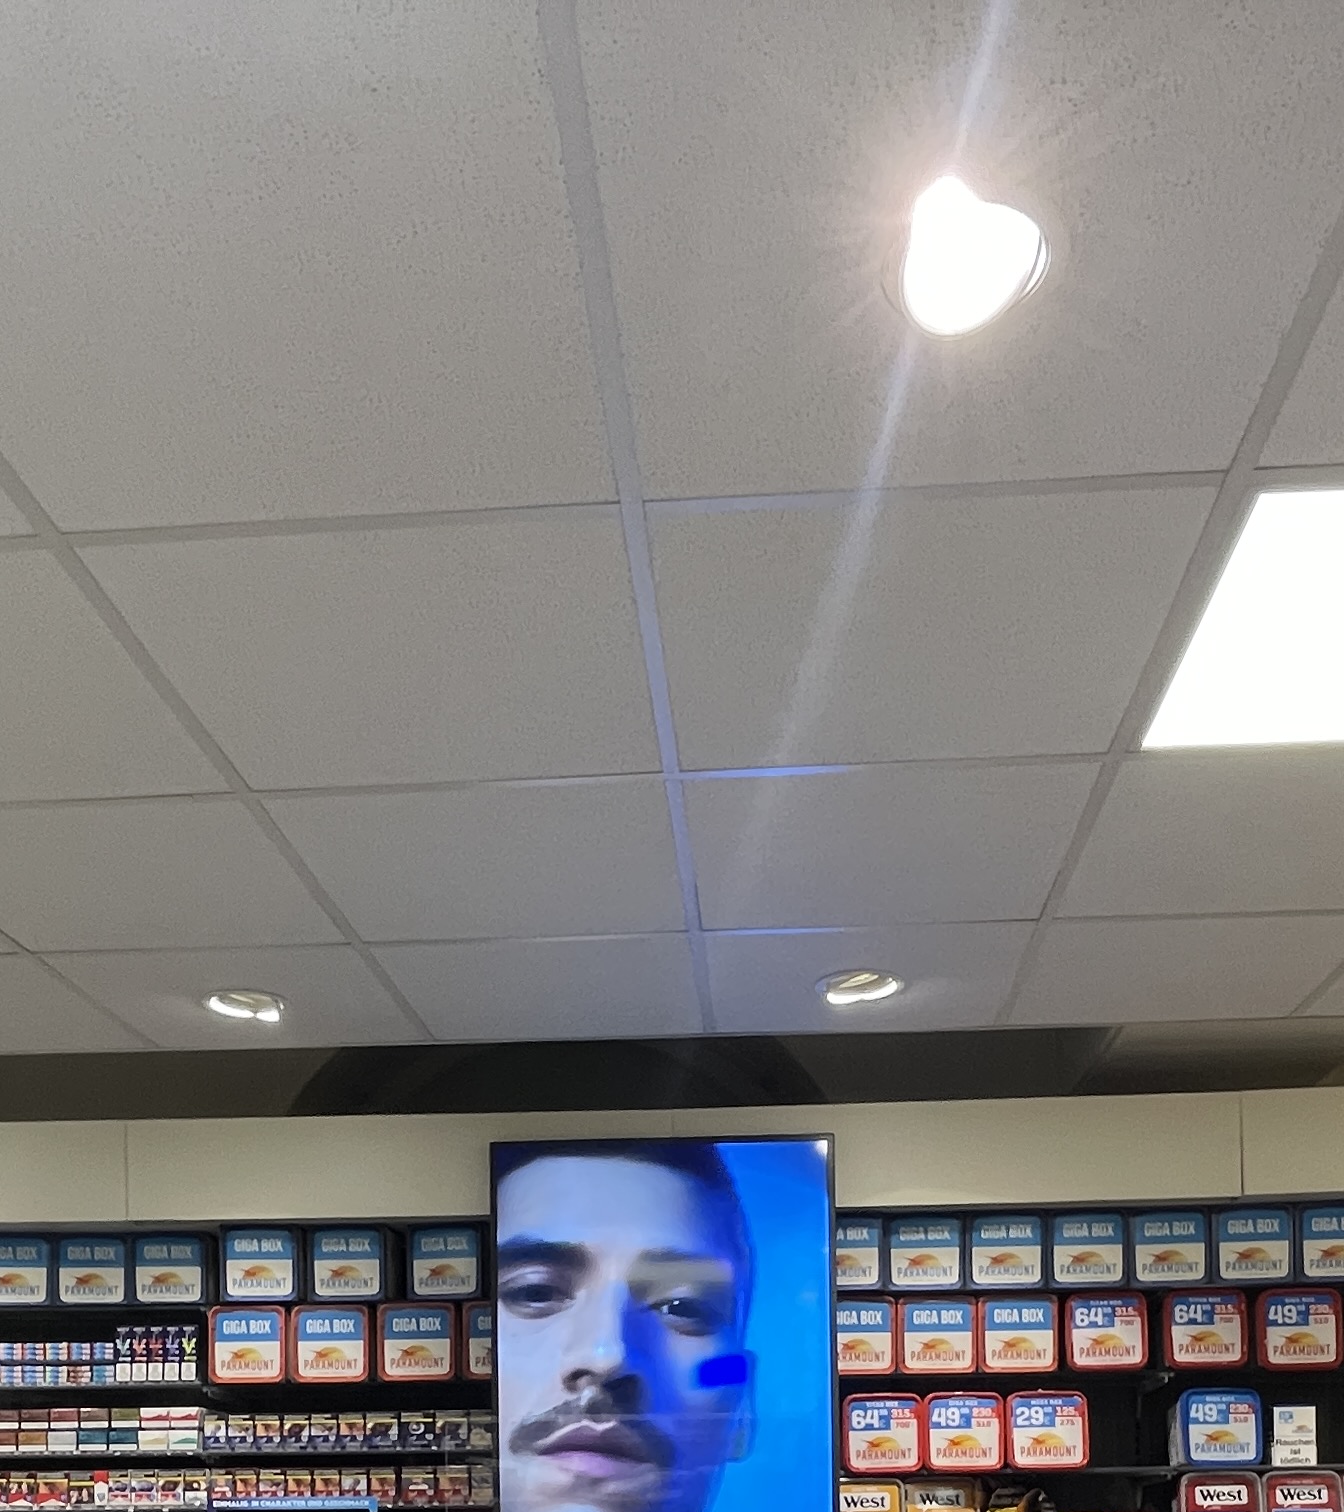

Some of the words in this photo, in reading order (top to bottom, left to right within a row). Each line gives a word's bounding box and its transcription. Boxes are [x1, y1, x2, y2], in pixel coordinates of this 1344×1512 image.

[1142, 1262, 1198, 1273] PARAMOUNT
[859, 1310, 883, 1325] BOX
[913, 1310, 937, 1324] GIGA
[939, 1310, 963, 1324] BOX
[994, 1309, 1019, 1323] GIGA
[1021, 1308, 1044, 1323] BOX
[223, 1318, 248, 1334] GIGA
[250, 1318, 271, 1334] BOX
[306, 1318, 331, 1333] GIGA
[334, 1318, 355, 1333] BOX
[392, 1317, 417, 1332] GIGA
[420, 1317, 441, 1332] BOX
[991, 1348, 1047, 1360] PARAMOUNT
[1079, 1345, 1136, 1358] PARAMOUNT
[1179, 1343, 1235, 1355] PARAMOUNT
[1273, 1344, 1330, 1356] PARAMOUNT
[910, 1350, 966, 1362] PARAMOUNT
[220, 1359, 275, 1371] PARAMOUNT
[304, 1359, 357, 1371] PARAMOUNT
[390, 1357, 445, 1370] PARAMOUNT
[856, 1448, 912, 1461] PARAMOUNT
[936, 1448, 992, 1459] PARAMOUNT
[1020, 1446, 1077, 1457] PARAMOUNT
[1194, 1442, 1250, 1454] PARAMOUNT
[844, 1495, 886, 1508] West
[920, 1493, 961, 1506] West
[1199, 1489, 1243, 1503] West
[1280, 1488, 1324, 1502] West
